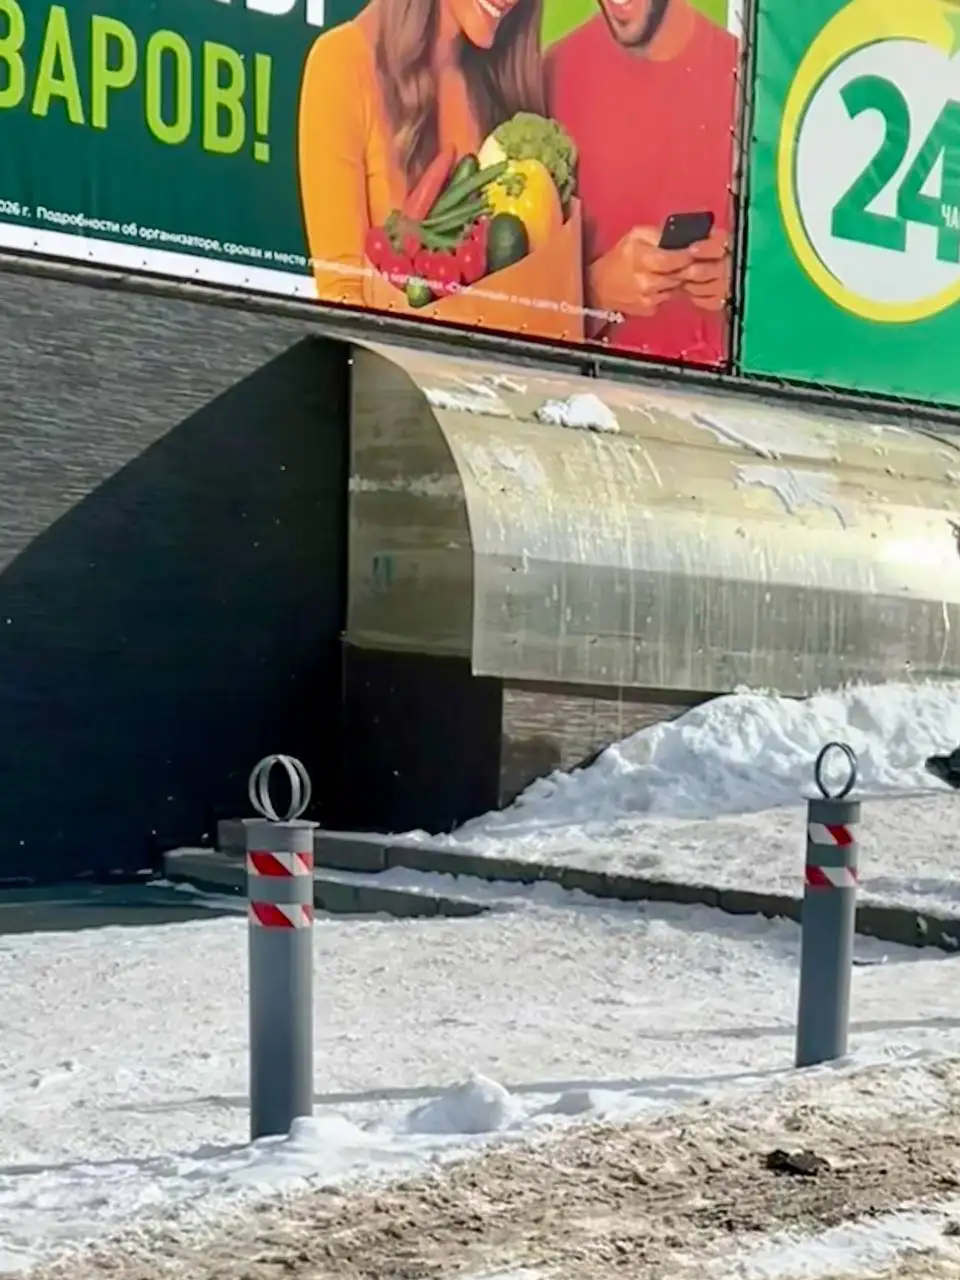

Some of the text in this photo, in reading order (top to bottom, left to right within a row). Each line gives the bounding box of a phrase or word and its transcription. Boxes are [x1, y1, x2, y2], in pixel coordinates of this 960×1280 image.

[0, 0, 272, 164] ВАРОВ!
[36, 206, 120, 233] Подробности
[121, 221, 138, 237] об
[139, 226, 222, 252] организаторе,
[223, 241, 263, 260] сроках
